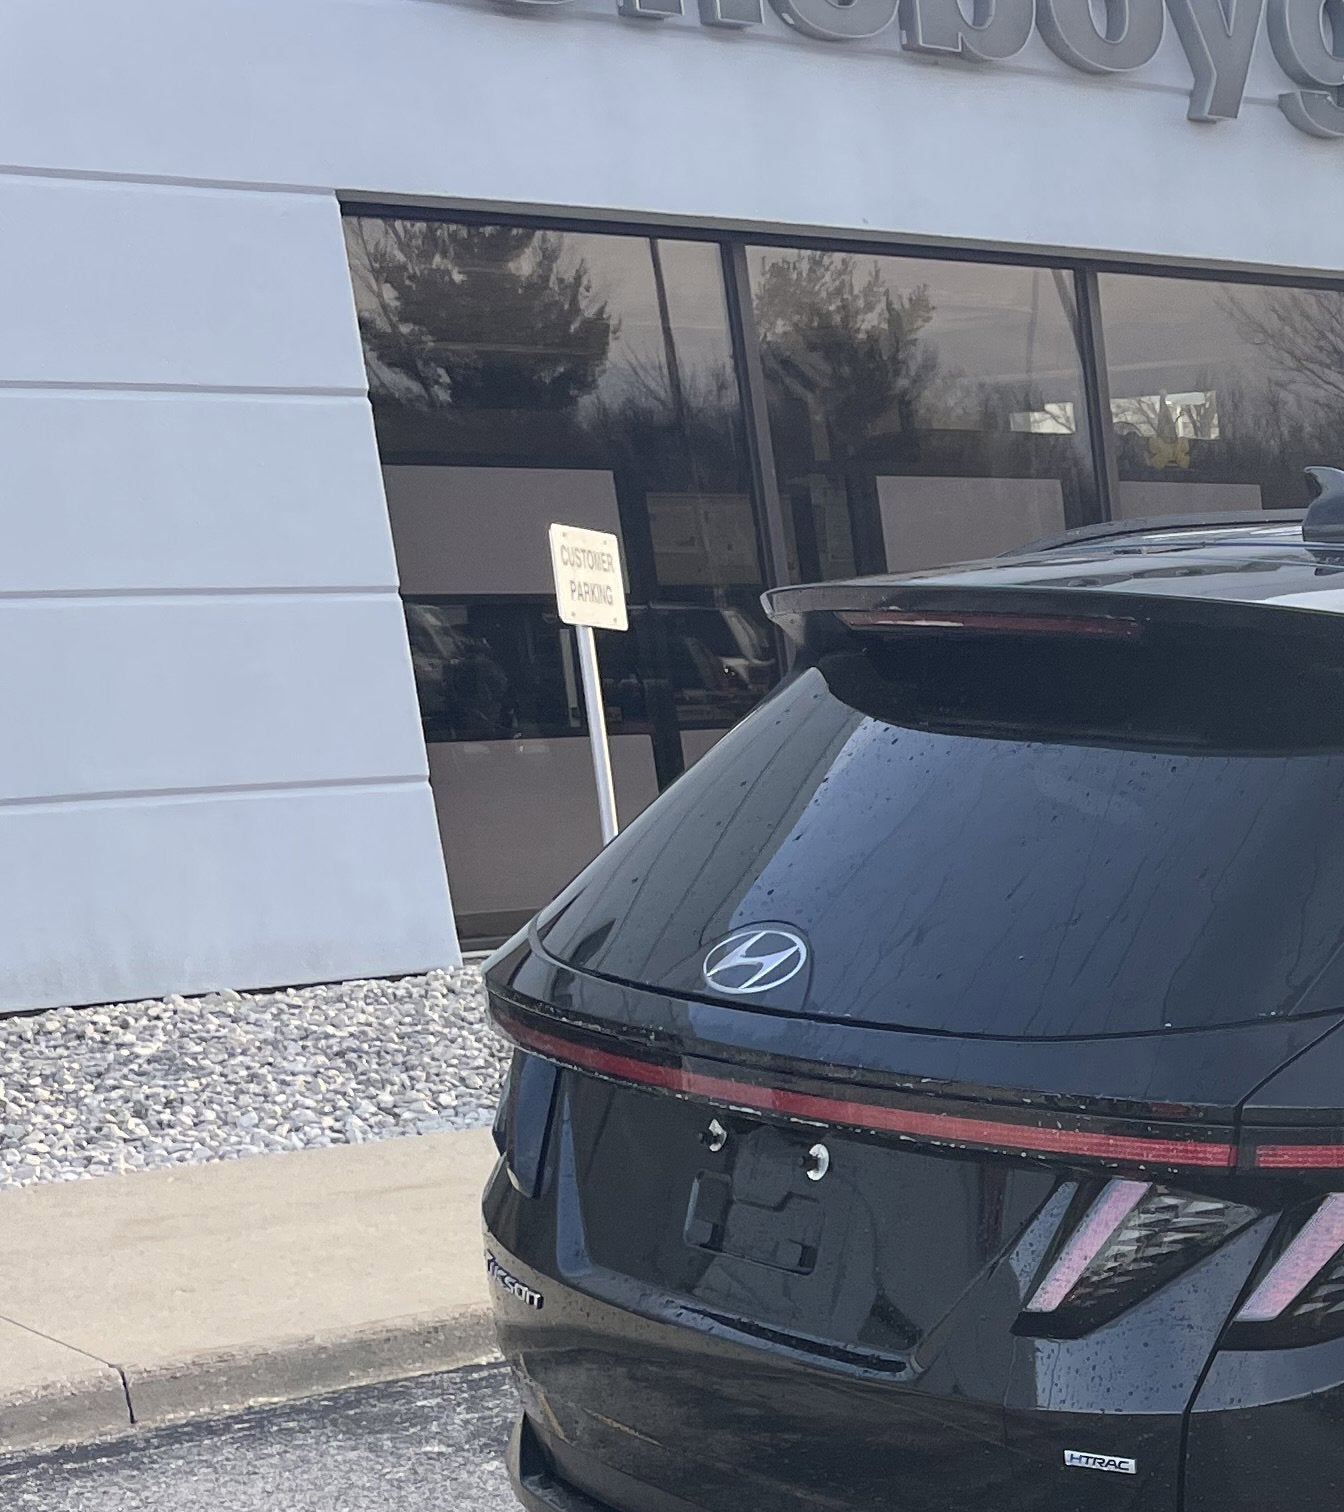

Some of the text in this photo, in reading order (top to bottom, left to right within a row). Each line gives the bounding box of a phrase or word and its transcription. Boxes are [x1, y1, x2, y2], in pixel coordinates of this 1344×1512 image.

[560, 544, 615, 573] CUSTOMER
[569, 579, 613, 606] PARKING
[1069, 1453, 1130, 1471] HTRAC
